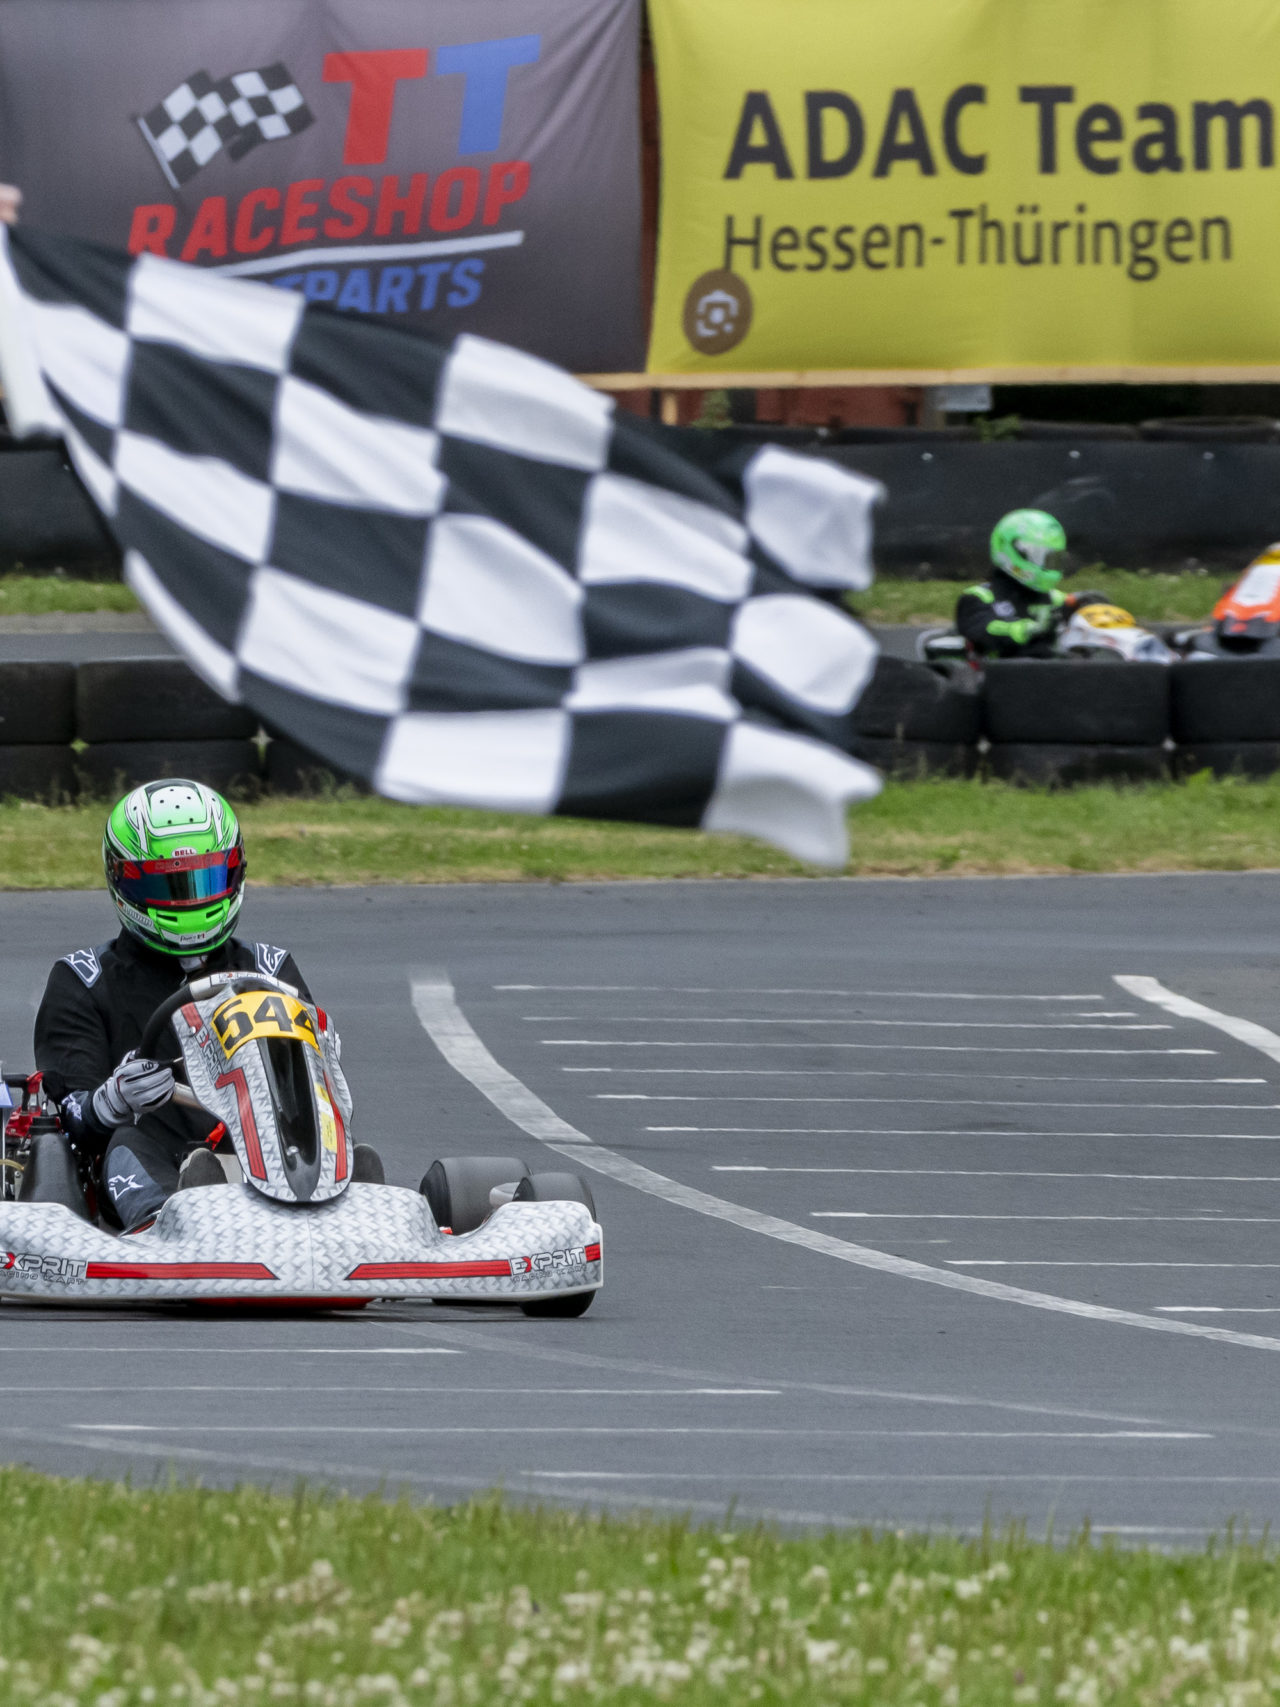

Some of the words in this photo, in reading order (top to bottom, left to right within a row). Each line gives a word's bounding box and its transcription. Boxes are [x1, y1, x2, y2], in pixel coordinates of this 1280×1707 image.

[322, 34, 542, 166] TT
[722, 84, 988, 181] ADAC
[1018, 84, 1276, 175] Team
[127, 161, 532, 263] RACESHOP
[722, 203, 1234, 282] Hessen-Thüringen
[173, 848, 195, 857] BELL
[510, 1246, 585, 1276] EXPRIT
